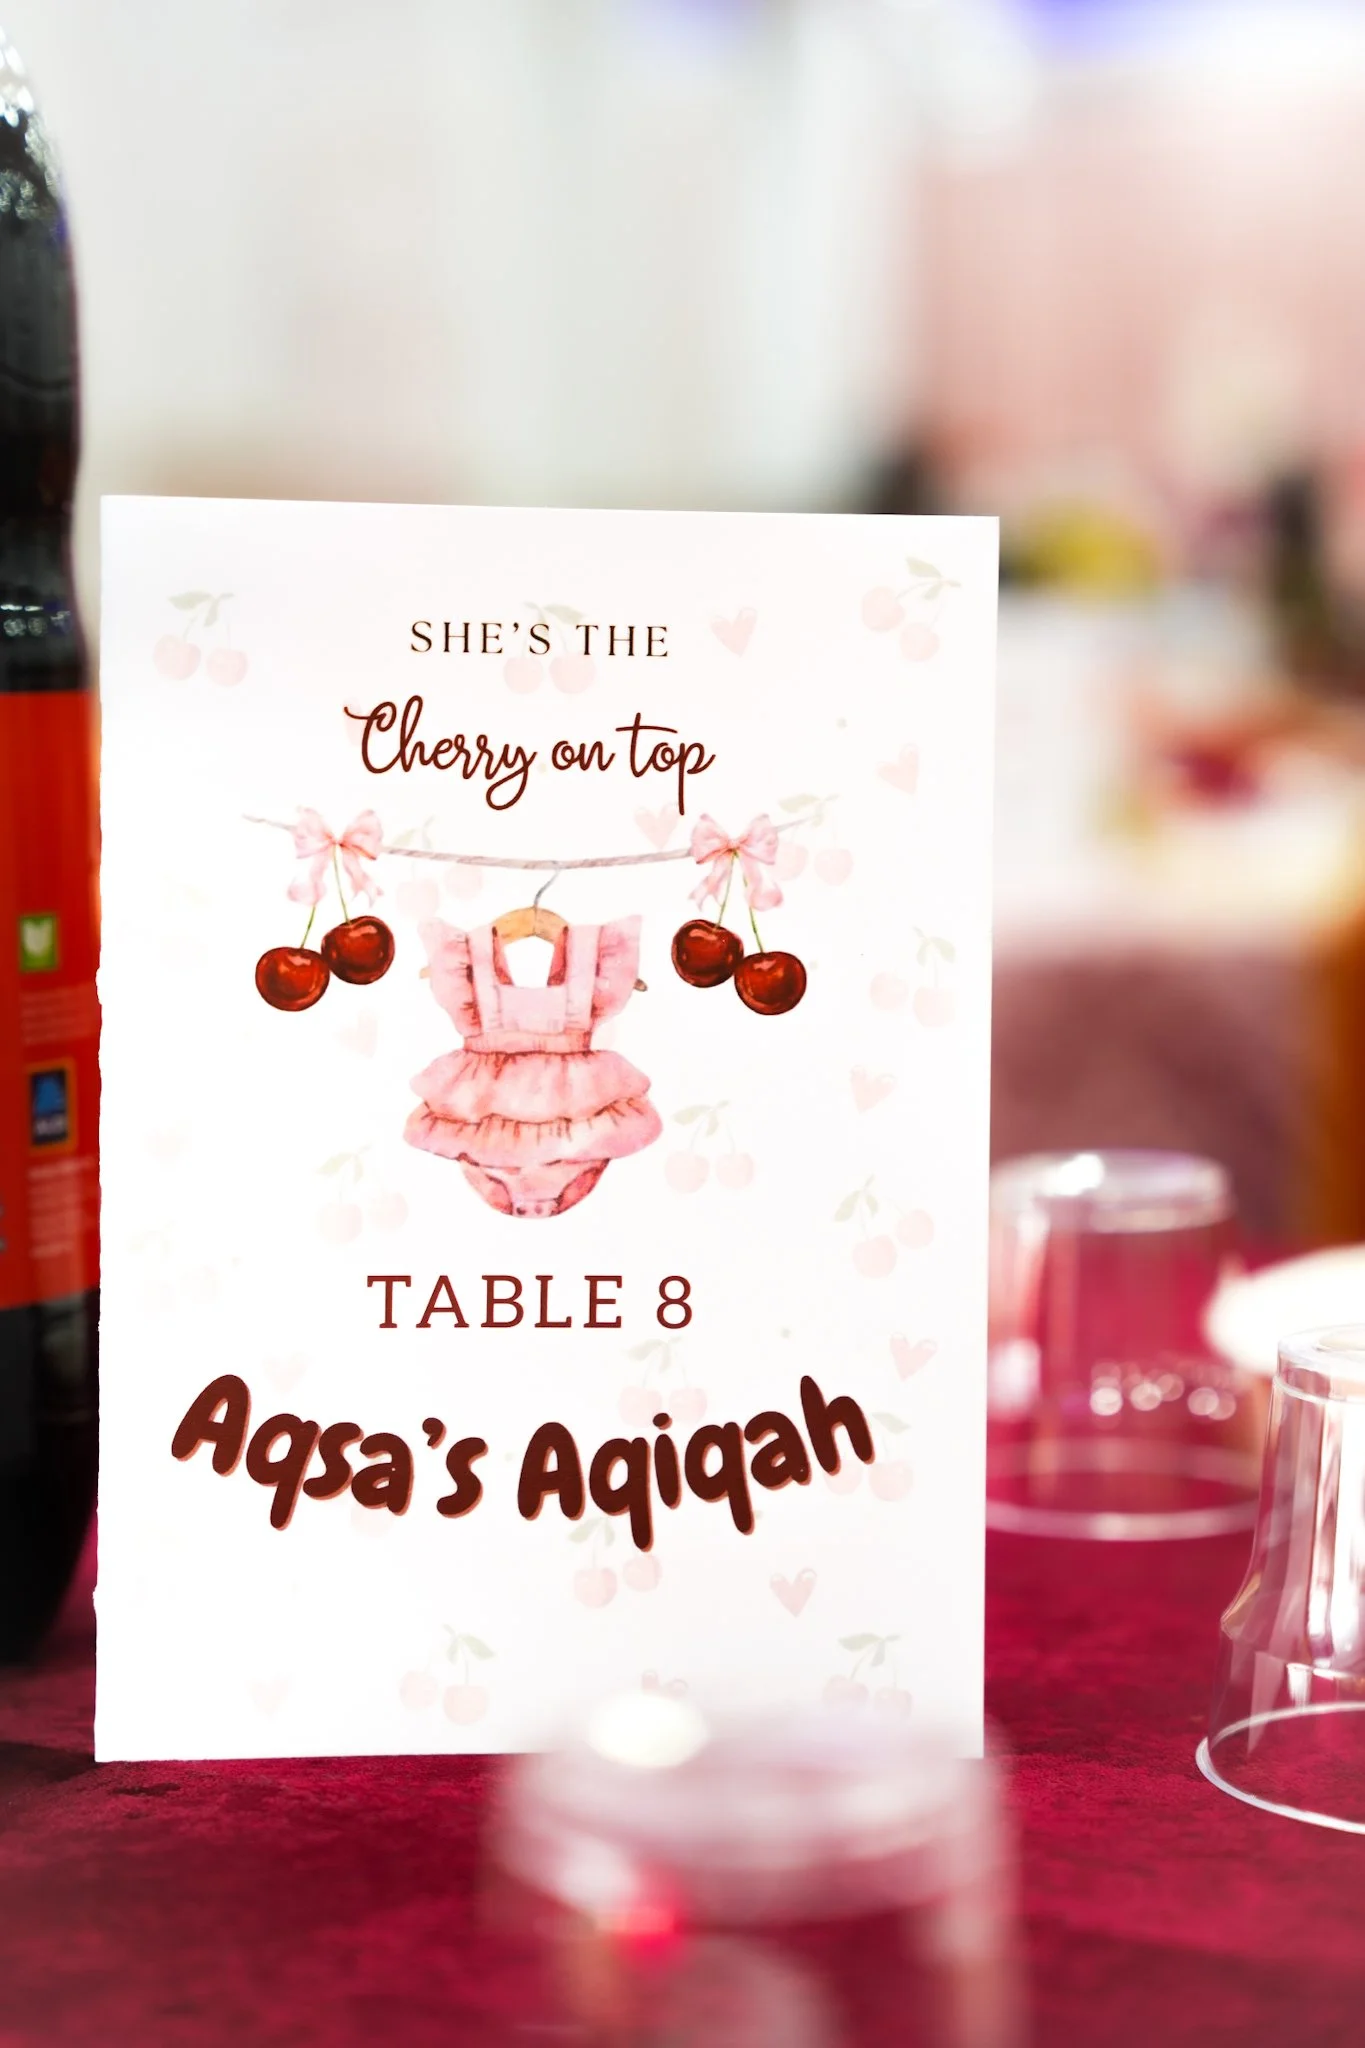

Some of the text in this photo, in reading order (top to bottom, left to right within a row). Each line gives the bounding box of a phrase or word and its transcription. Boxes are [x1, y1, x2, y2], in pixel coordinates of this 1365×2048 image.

[410, 620, 669, 658] SHE’S THE
[343, 694, 717, 816] Cherry on top
[367, 1275, 693, 1330] TABLE 8
[171, 1374, 876, 1552] Aqsa’s Aqiqah
